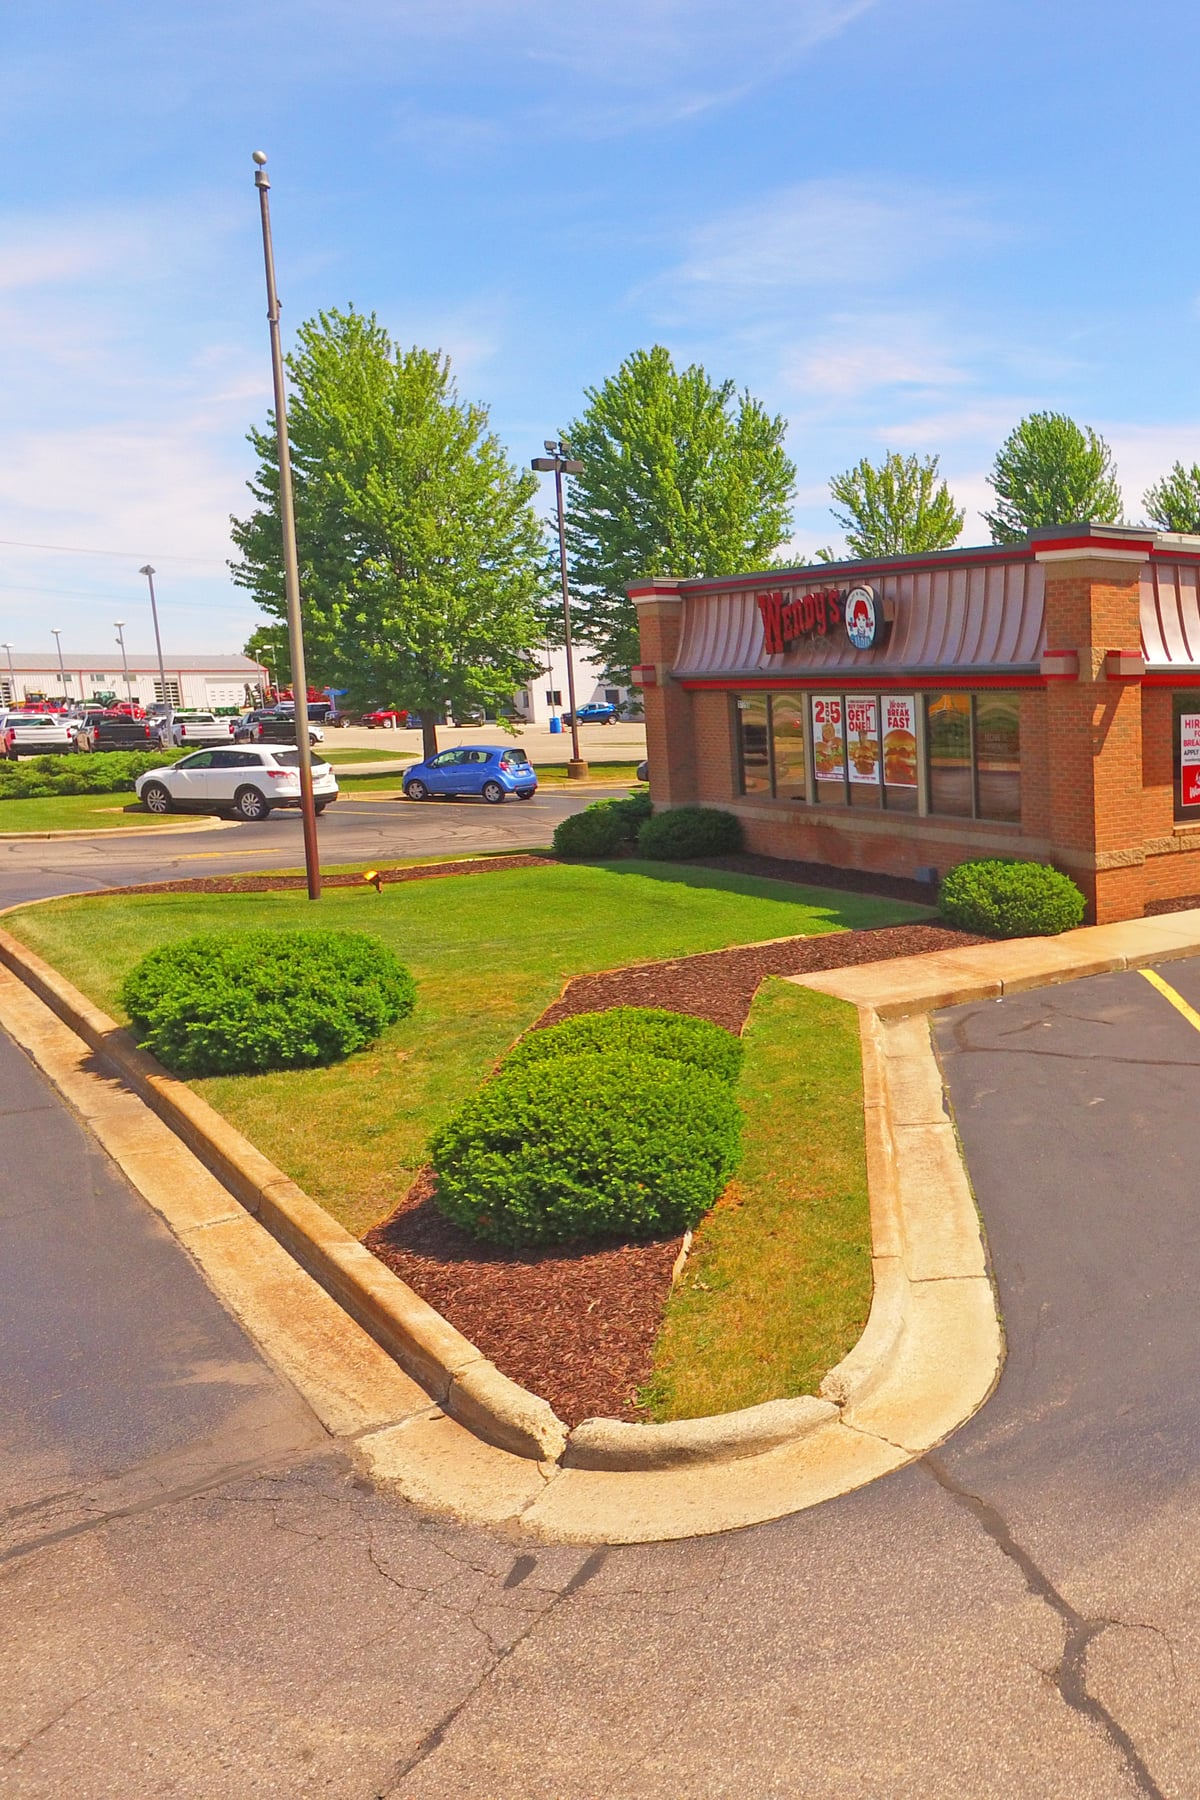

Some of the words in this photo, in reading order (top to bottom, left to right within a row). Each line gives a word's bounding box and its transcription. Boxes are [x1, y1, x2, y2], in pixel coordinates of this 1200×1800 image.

[815, 700, 825, 723] 2
[830, 701, 841, 724] 5
[848, 709, 865, 721] GET
[849, 722, 866, 732] ONE
[887, 717, 910, 729] FAST
